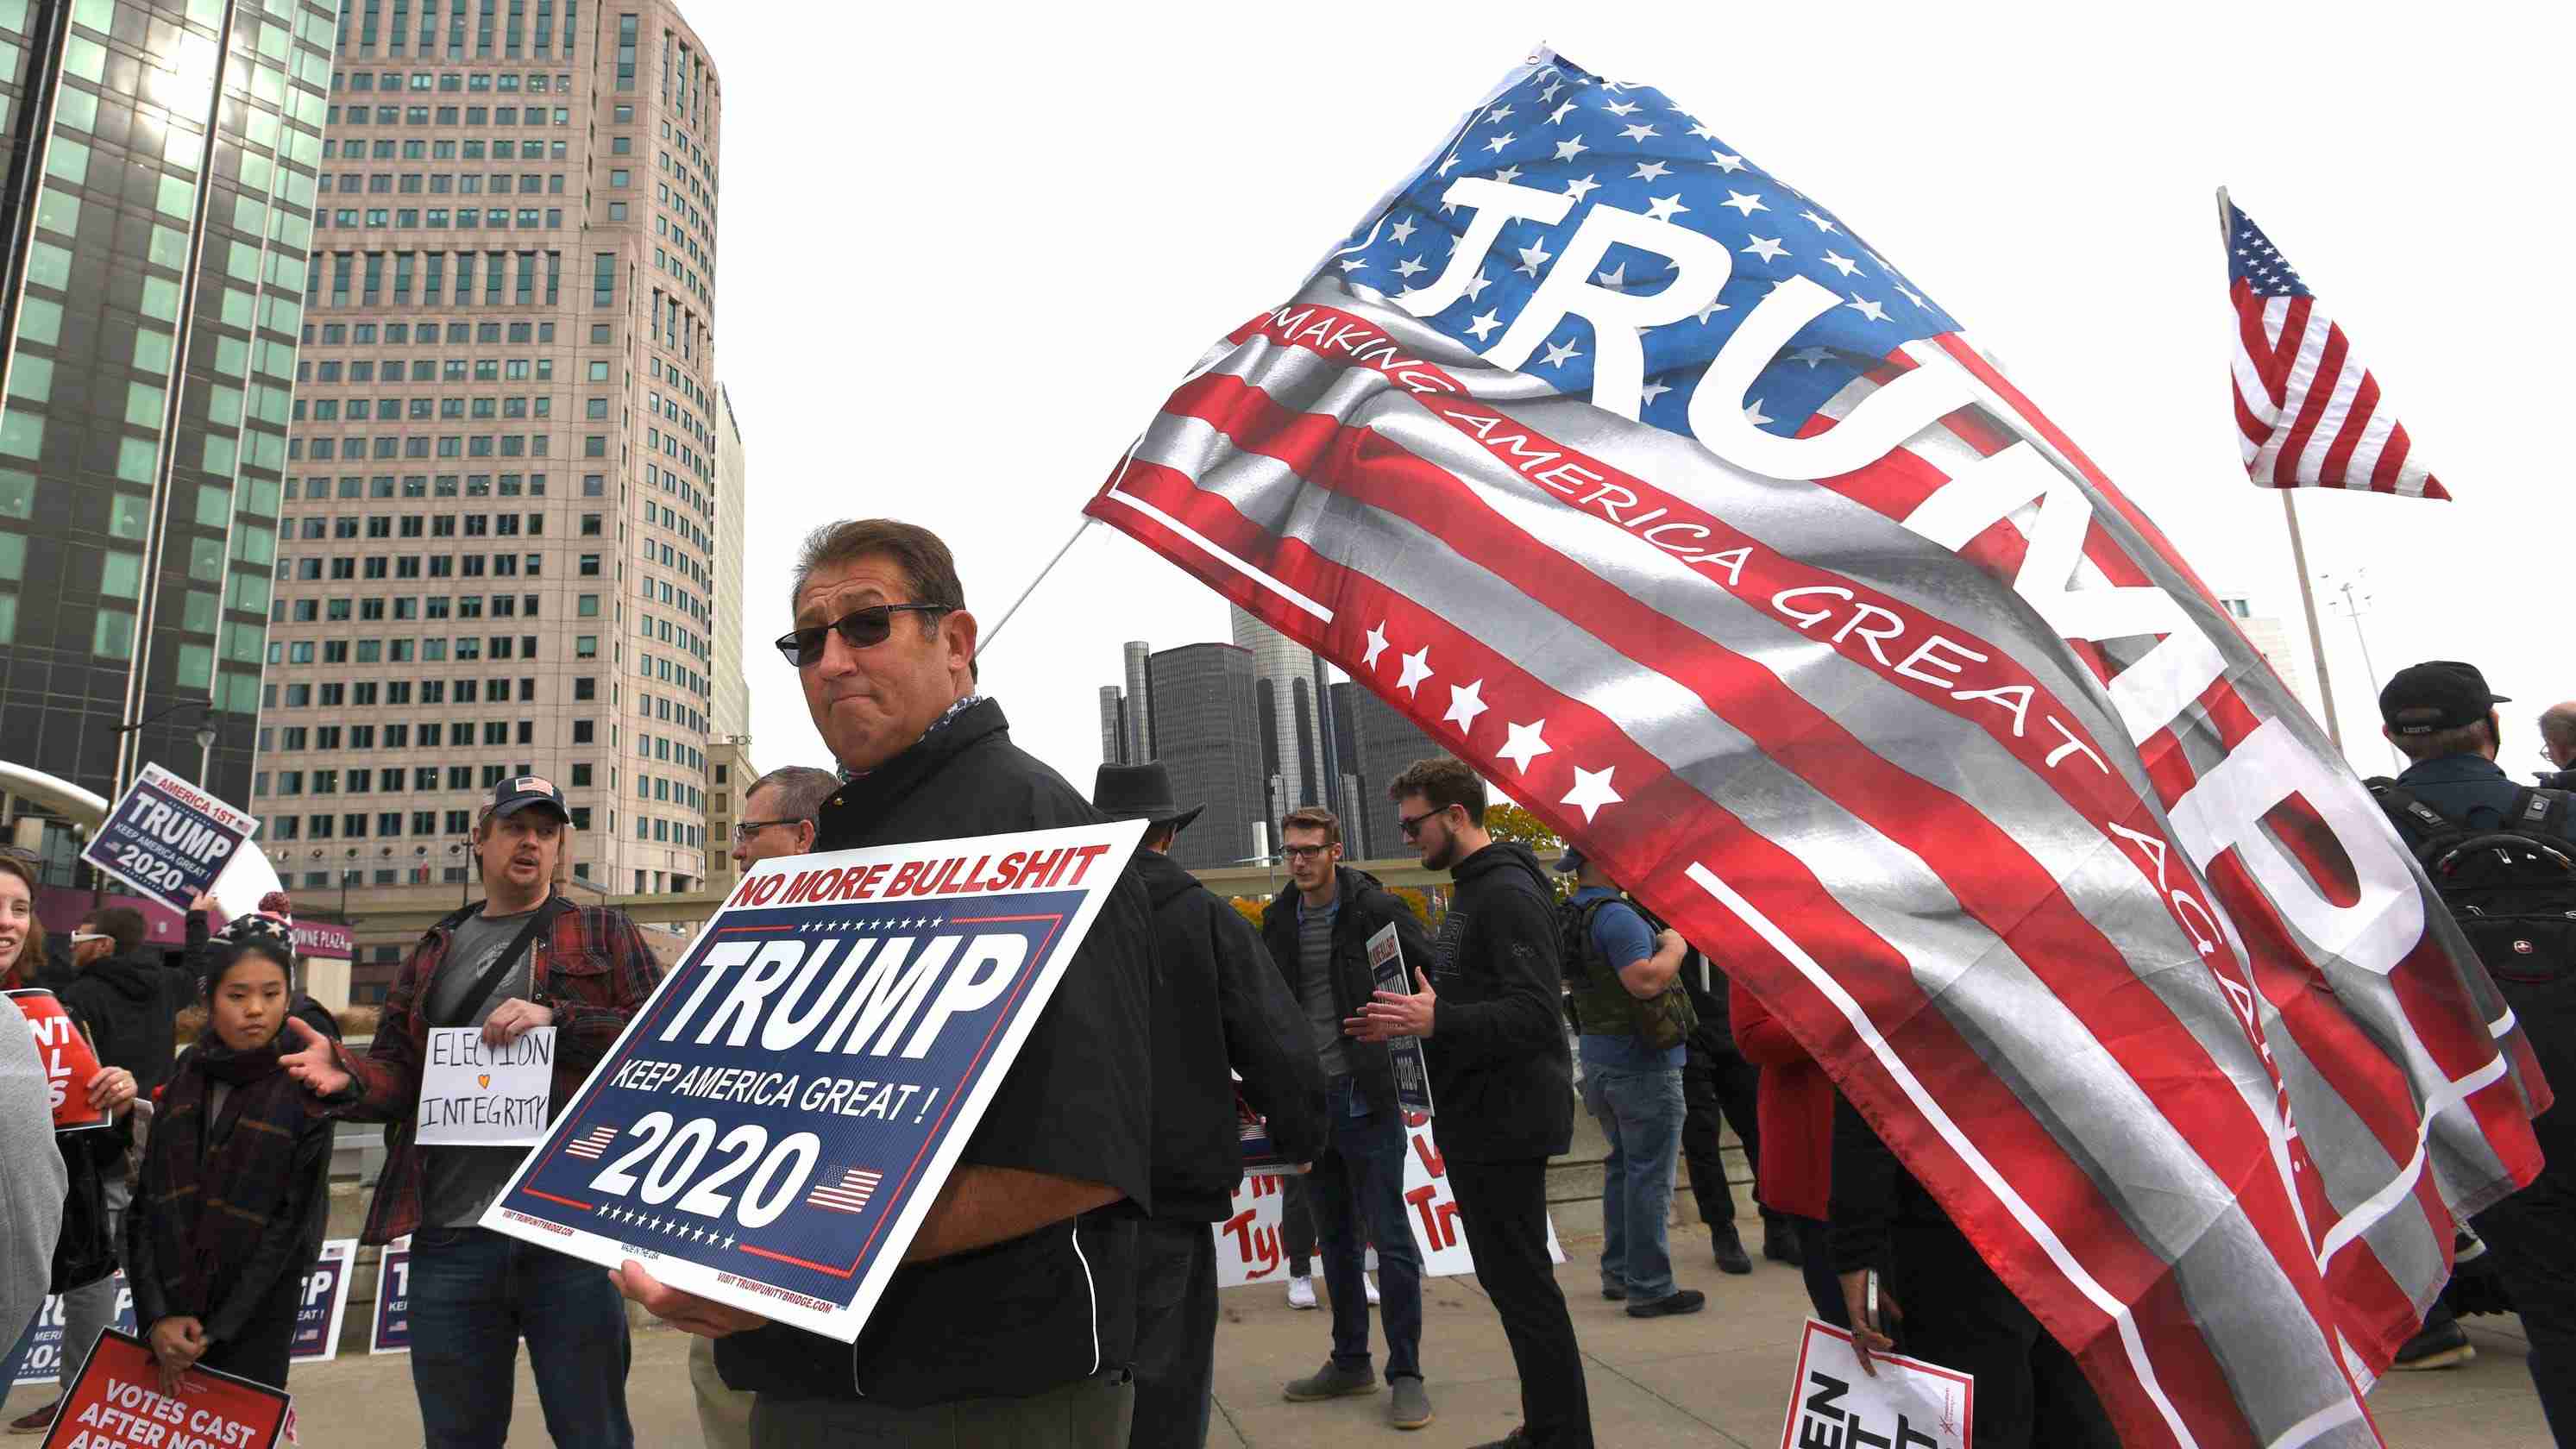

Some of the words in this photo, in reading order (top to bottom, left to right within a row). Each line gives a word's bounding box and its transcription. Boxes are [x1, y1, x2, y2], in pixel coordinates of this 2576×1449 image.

[1266, 306, 1456, 394] MAKING
[1444, 410, 1753, 586] AMERICA
[1771, 586, 2109, 775] GREAT
[1387, 176, 2426, 976] TRUMP
[128, 792, 232, 864] TRUMP
[157, 778, 210, 814] AMERICA
[213, 805, 236, 825] 1ST
[114, 823, 139, 839] KEEP
[136, 837, 176, 862] AMERICA
[175, 856, 207, 877] GREAT
[117, 845, 184, 891] 2020
[728, 873, 788, 907] NO
[778, 863, 893, 906] MORE
[883, 844, 1112, 898] BULLSHIT
[294, 929, 318, 947] OWNE
[320, 931, 346, 949] PLAZA
[660, 933, 1028, 1059] TRUMP
[433, 1032, 550, 1066] ELECTION
[420, 1095, 548, 1130] INTEGRITY
[610, 1060, 682, 1091] KEEP
[671, 1066, 801, 1107] AMERICA
[801, 1076, 923, 1121] GREAT
[588, 1111, 820, 1228] 2020
[717, 1272, 738, 1285] VISIT
[736, 1277, 833, 1314] TRUMPUNITYBRIDGE.COM
[77, 1402, 166, 1449] AFTER
[104, 1378, 187, 1424] VOTES
[190, 1409, 255, 1449] CAST
